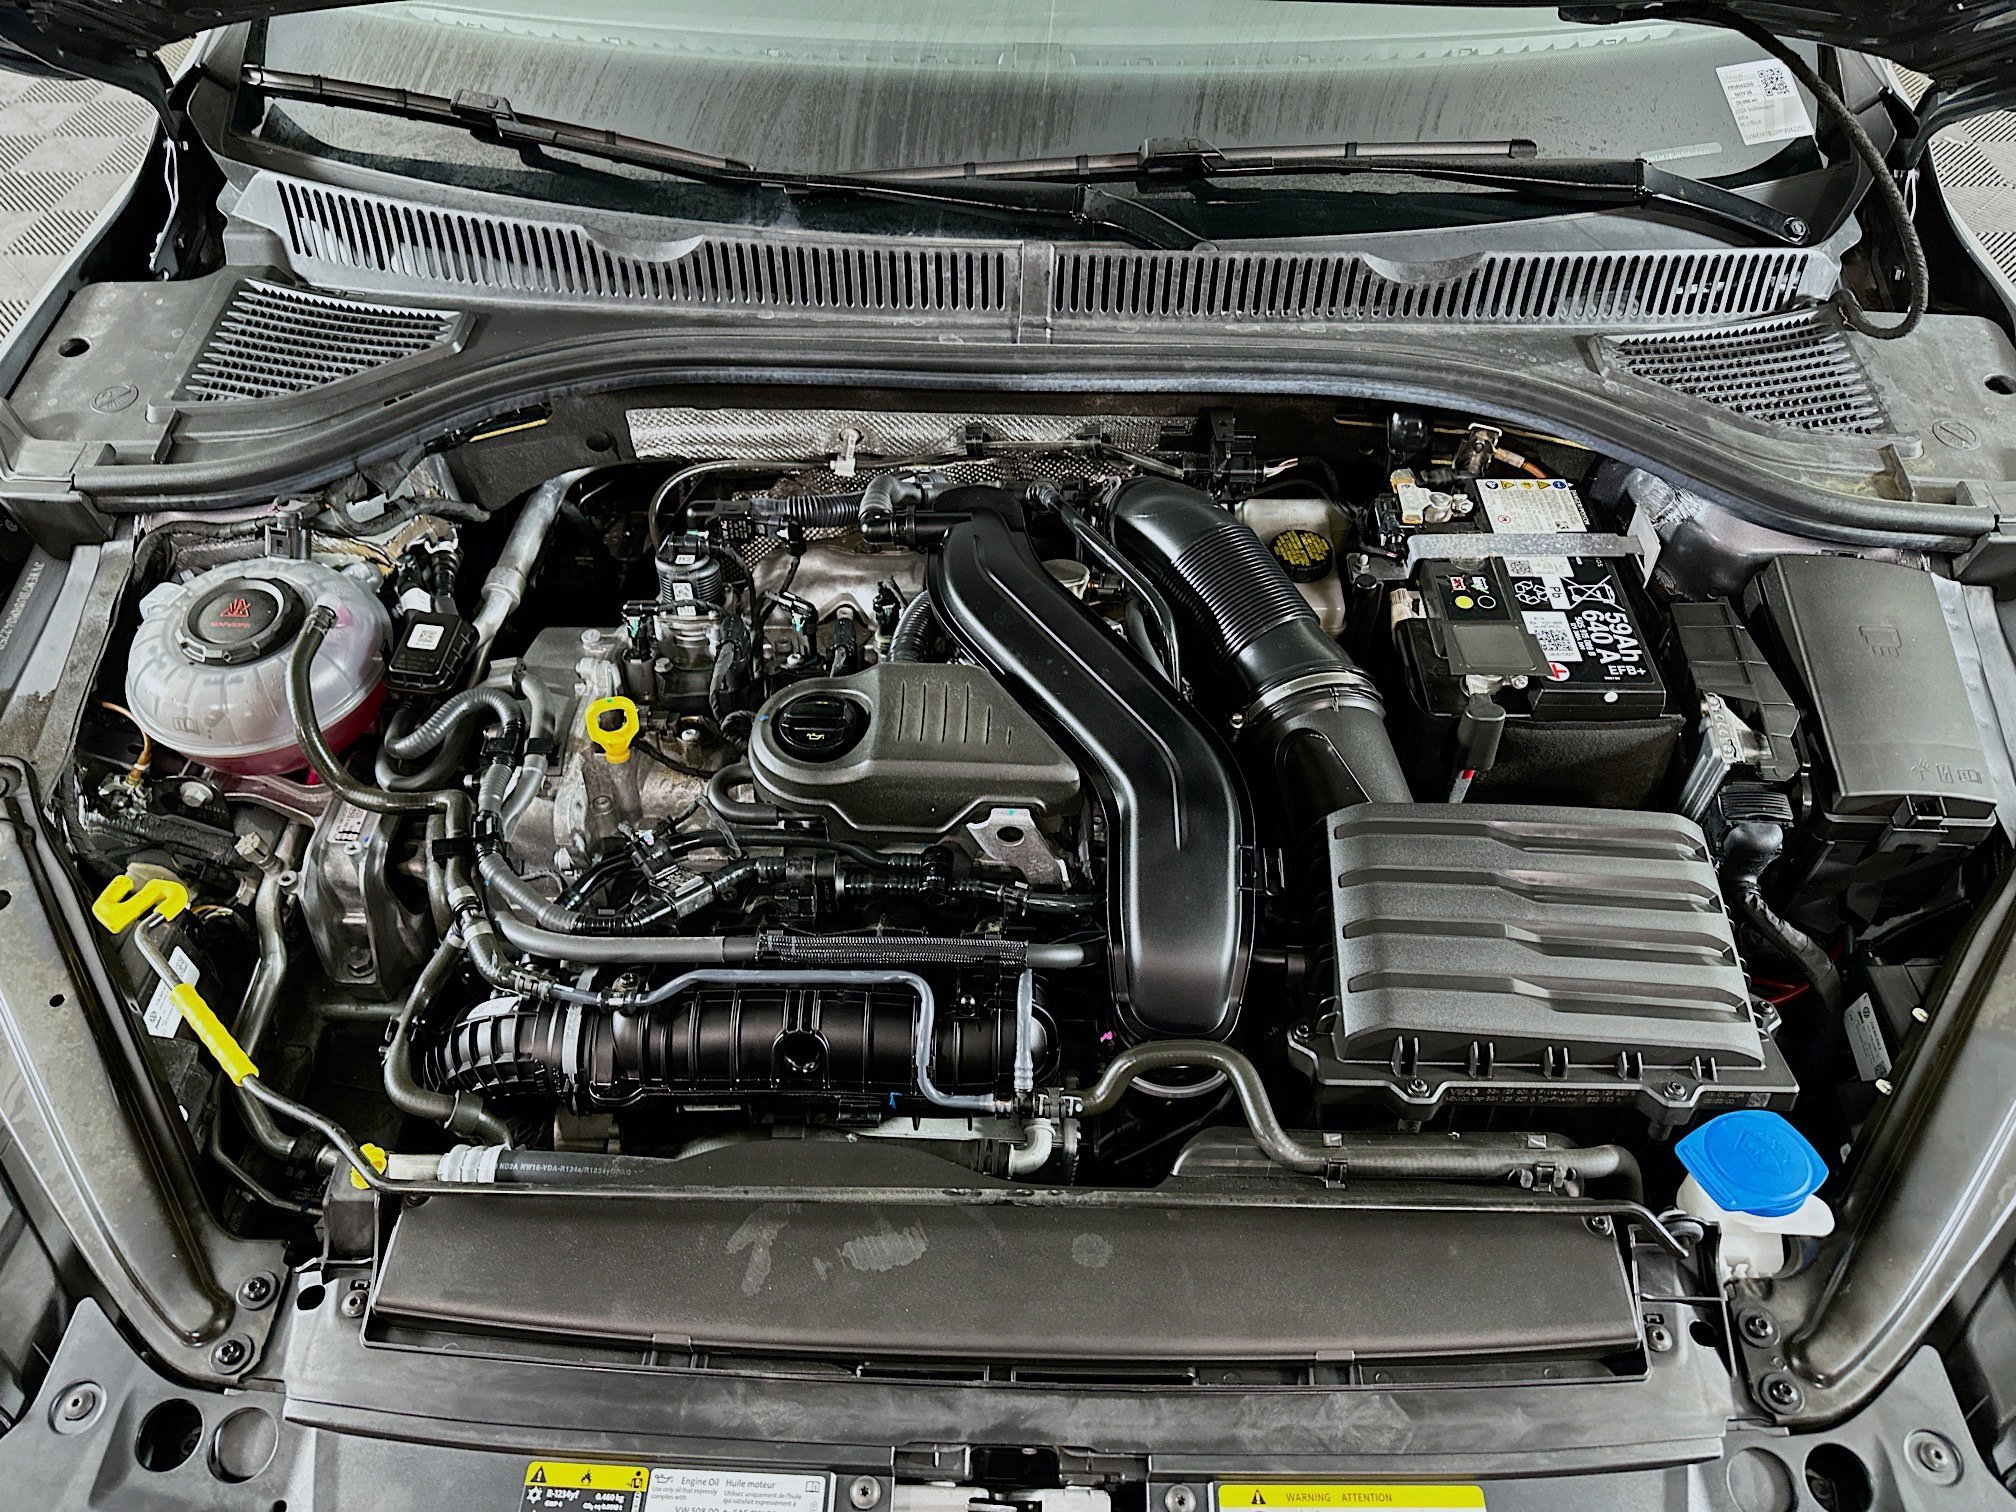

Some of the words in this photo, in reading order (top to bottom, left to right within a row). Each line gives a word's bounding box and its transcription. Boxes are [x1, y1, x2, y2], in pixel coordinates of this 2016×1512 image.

[1550, 586, 1562, 598] Pb
[1582, 610, 1614, 644] 640
[1605, 611, 1643, 662] 59Ah
[1596, 648, 1621, 664] A
[1608, 665, 1646, 676] EFB+
[682, 1477, 706, 1487] Engine
[708, 1478, 720, 1486] Oil
[726, 1480, 746, 1488] Huile
[546, 1489, 580, 1501] R-1234yf
[616, 1494, 624, 1504] kg
[745, 1492, 777, 1500] uniquement
[1286, 1492, 1331, 1502] WARNING
[1342, 1492, 1393, 1502] ATTENTION
